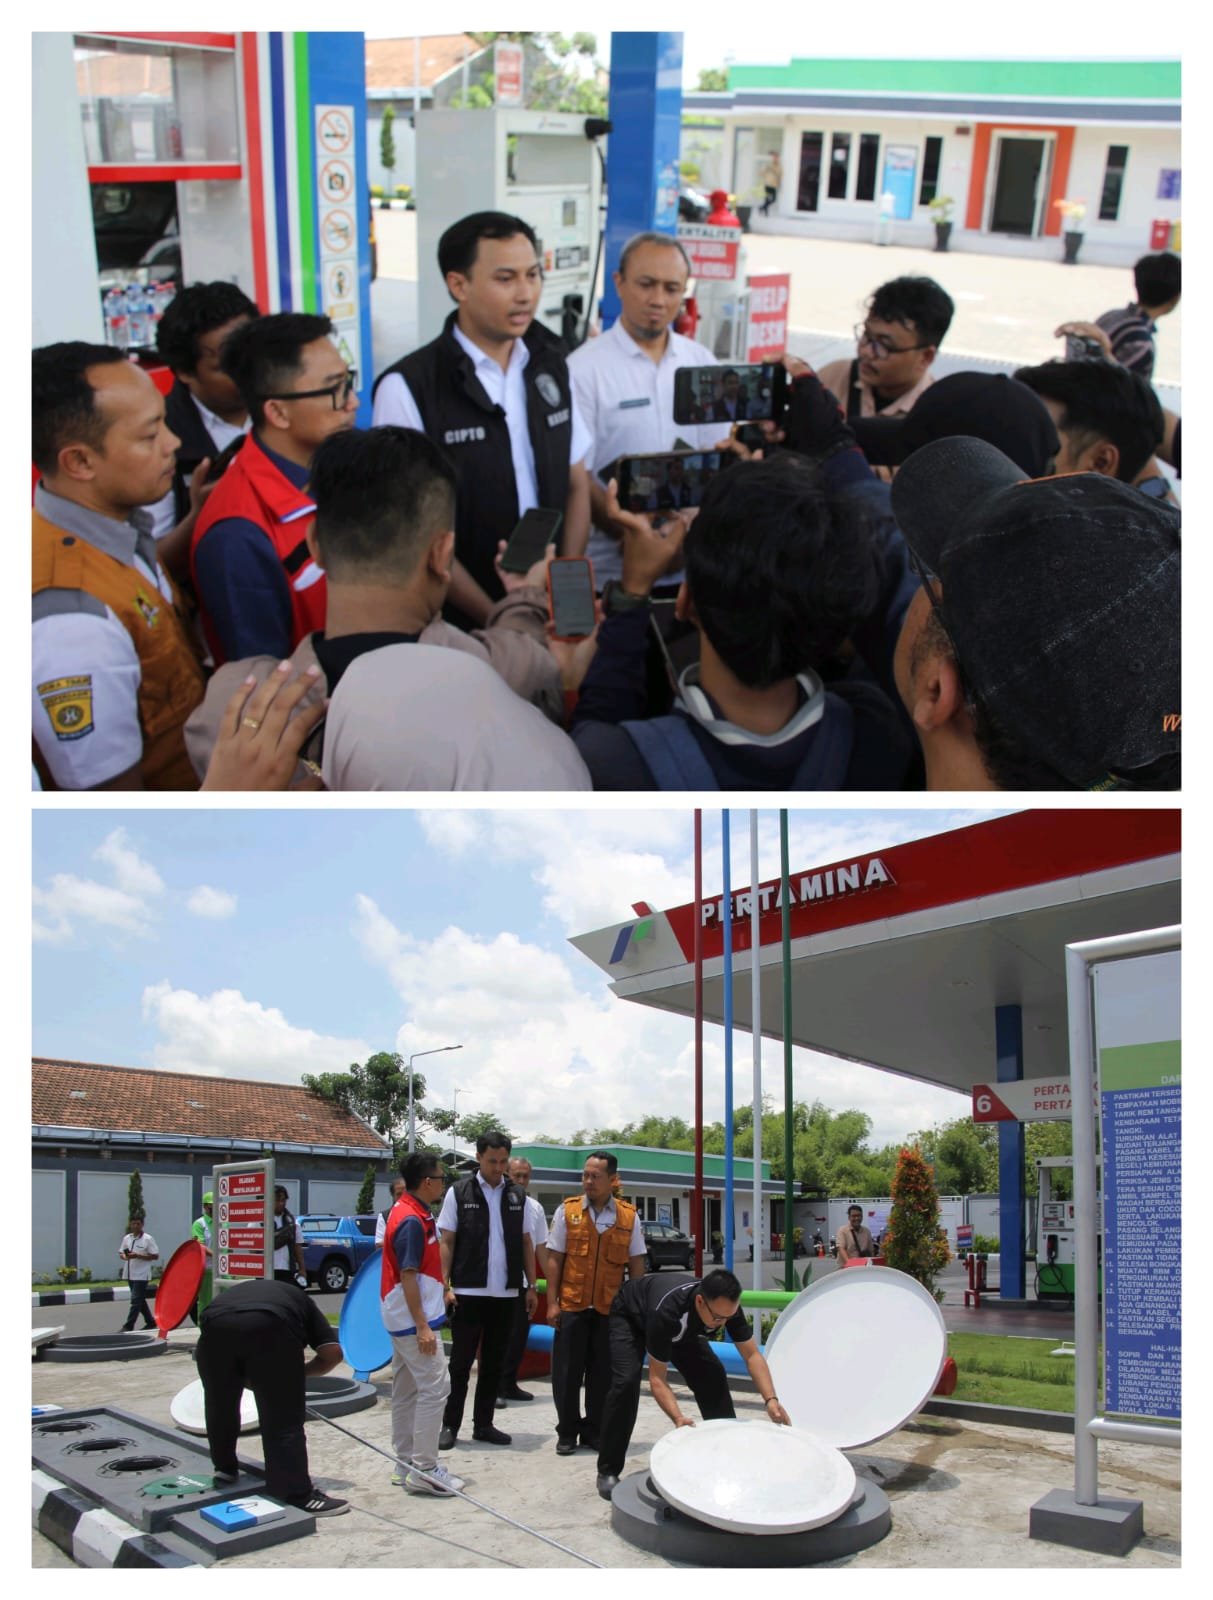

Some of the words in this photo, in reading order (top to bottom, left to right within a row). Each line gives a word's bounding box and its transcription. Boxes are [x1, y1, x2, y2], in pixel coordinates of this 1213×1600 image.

[679, 226, 736, 239] ERTALITE
[751, 285, 787, 313] HELP
[444, 426, 486, 445] CIPTO
[701, 857, 890, 927] PERTAMINA
[1114, 1092, 1150, 1100] PASTIKAN
[976, 1094, 992, 1113] 6
[1114, 1101, 1159, 1109] TEMPATKAN
[1114, 1118, 1160, 1126] KENDARAAN
[1116, 1134, 1155, 1142] TURUNKAN
[1116, 1169, 1162, 1177] PERSIAPKAN
[1116, 1177, 1148, 1185] PERIKSA
[1118, 1321, 1164, 1330] SELESAIKAN
[1118, 1366, 1156, 1374] DILARANG
[1144, 1388, 1172, 1396] TANGKI
[1118, 1393, 1165, 1402] KENDARAAN
[1144, 1402, 1172, 1410] LOKASI
